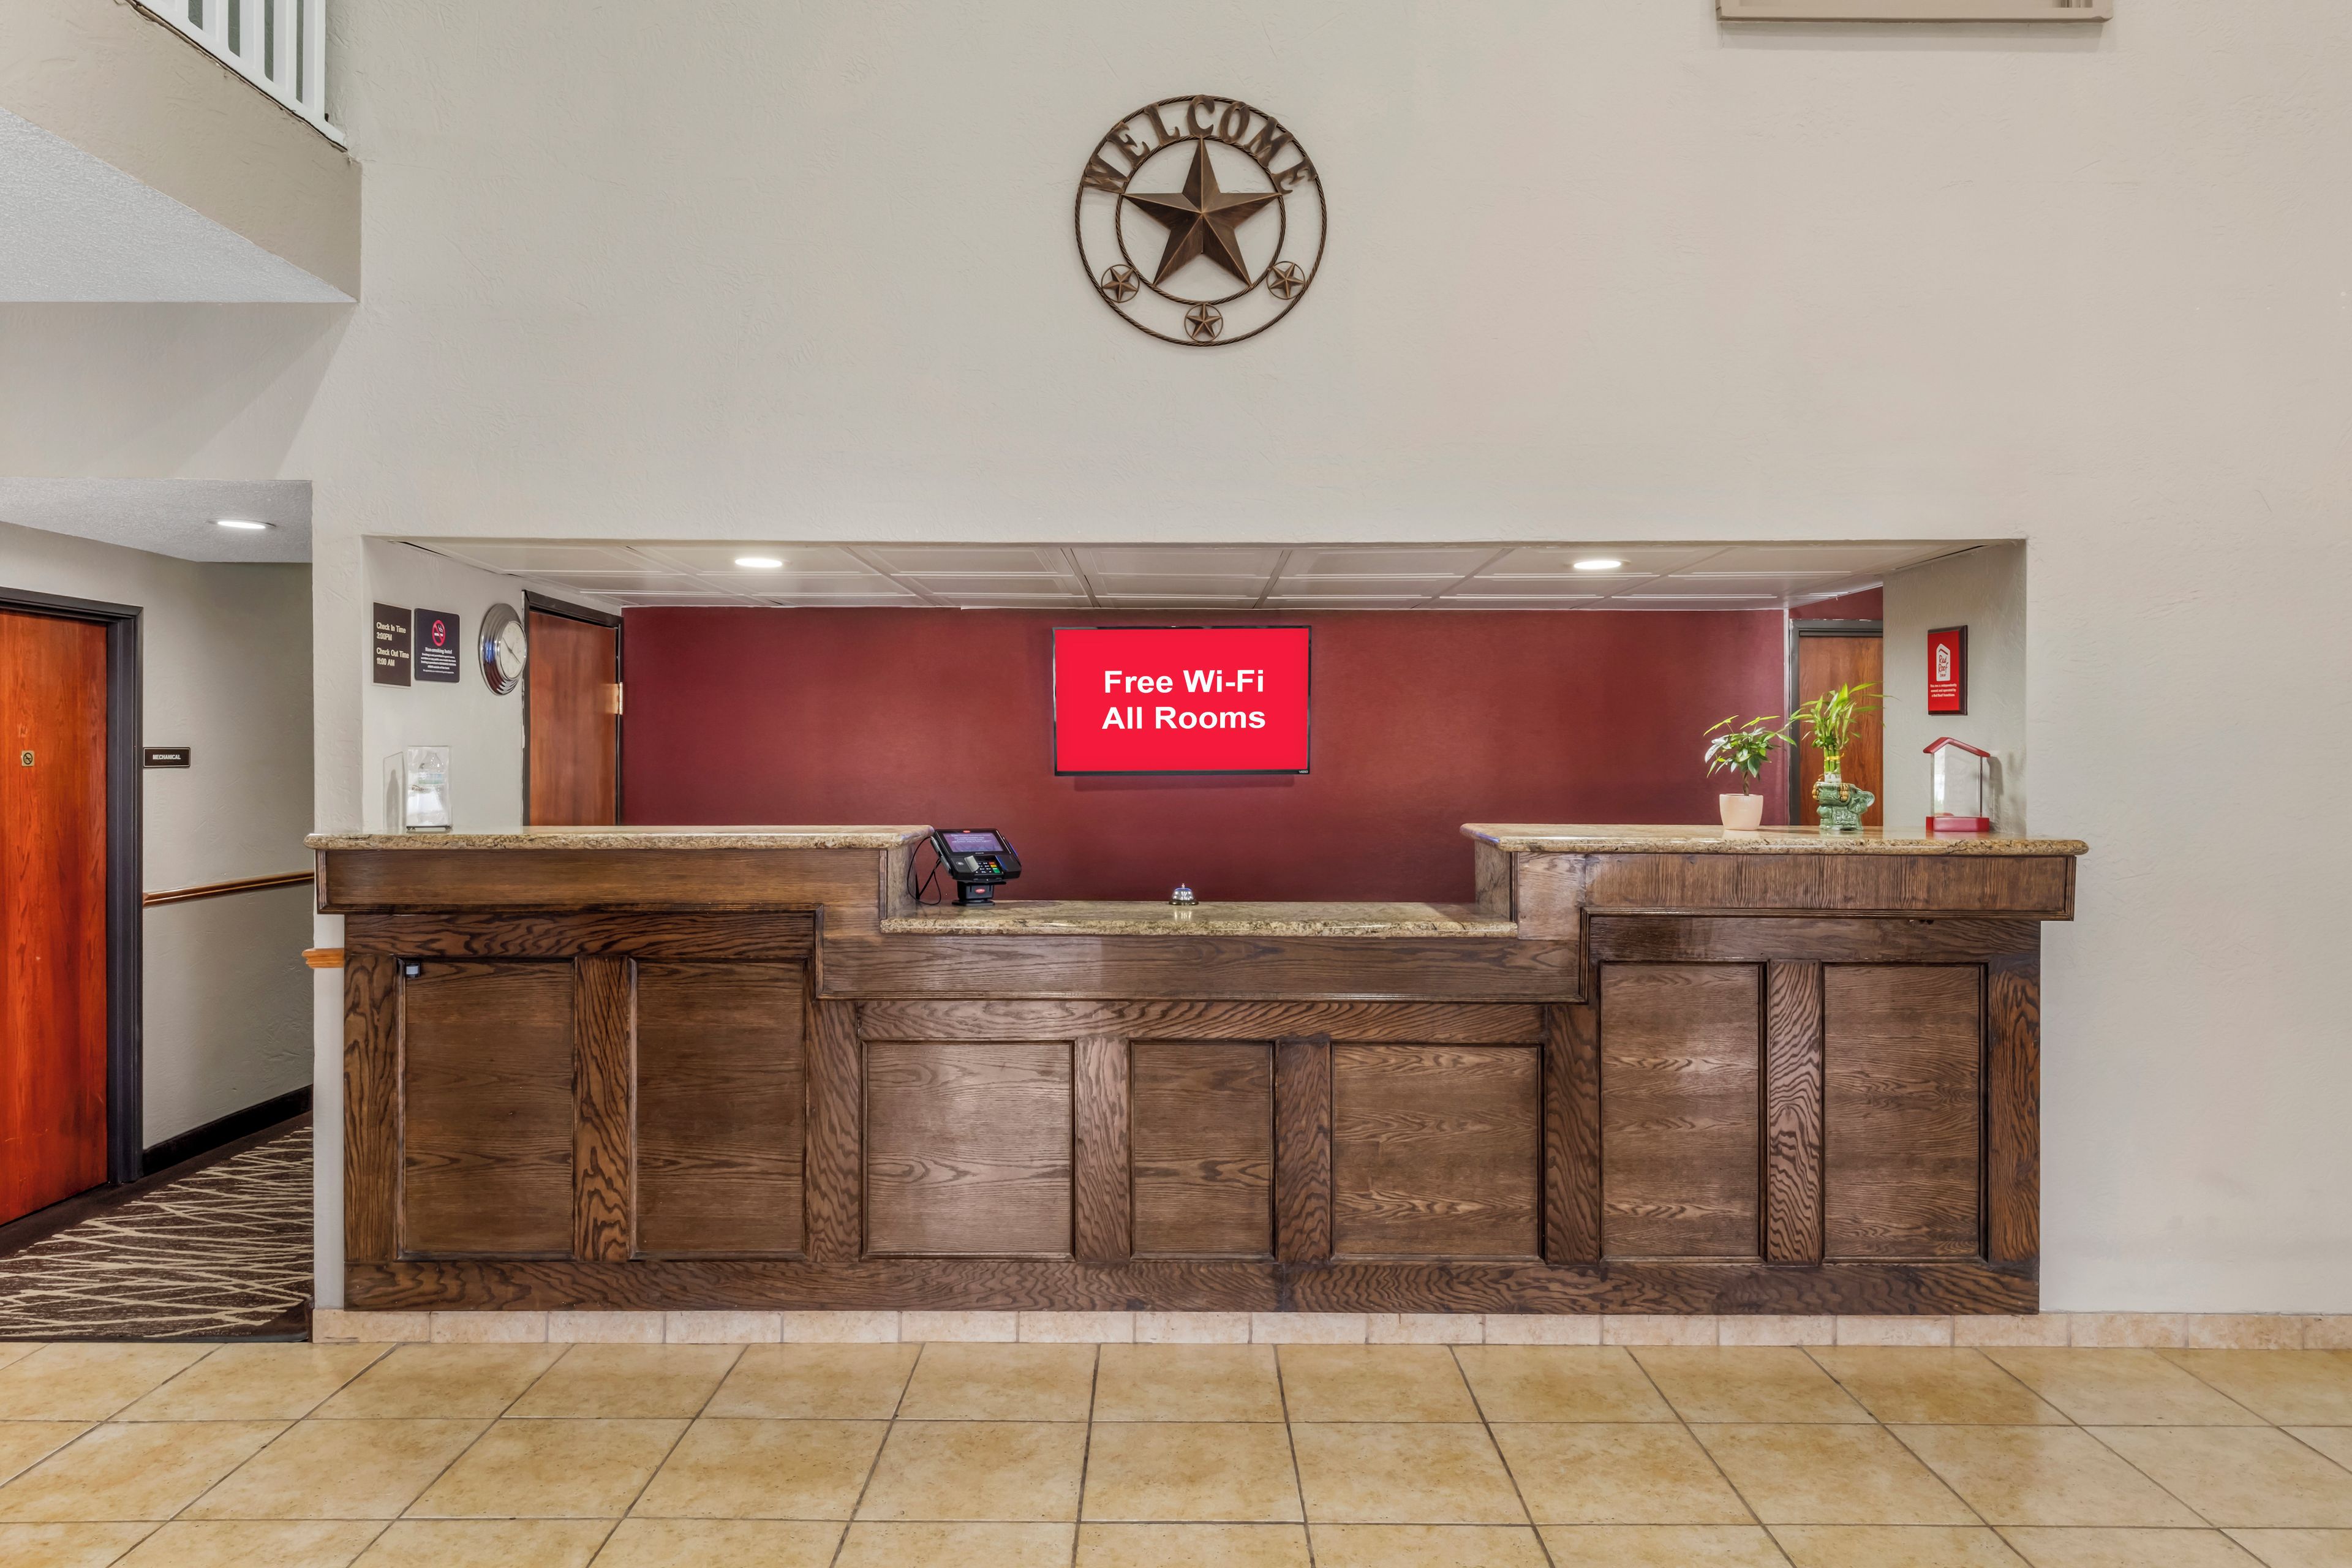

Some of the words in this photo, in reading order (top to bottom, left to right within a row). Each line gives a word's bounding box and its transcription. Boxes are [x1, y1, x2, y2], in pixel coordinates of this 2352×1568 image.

[1082, 94, 1318, 194] WELCOME
[377, 622, 390, 631] Check
[377, 632, 392, 641] 3:00PM
[377, 647, 390, 655] Check
[1939, 662, 1948, 674] Roof
[1104, 670, 1174, 693] Free
[1183, 669, 1264, 693] Wi-Fi
[1101, 706, 1142, 729] All
[1155, 706, 1266, 729] Rooms
